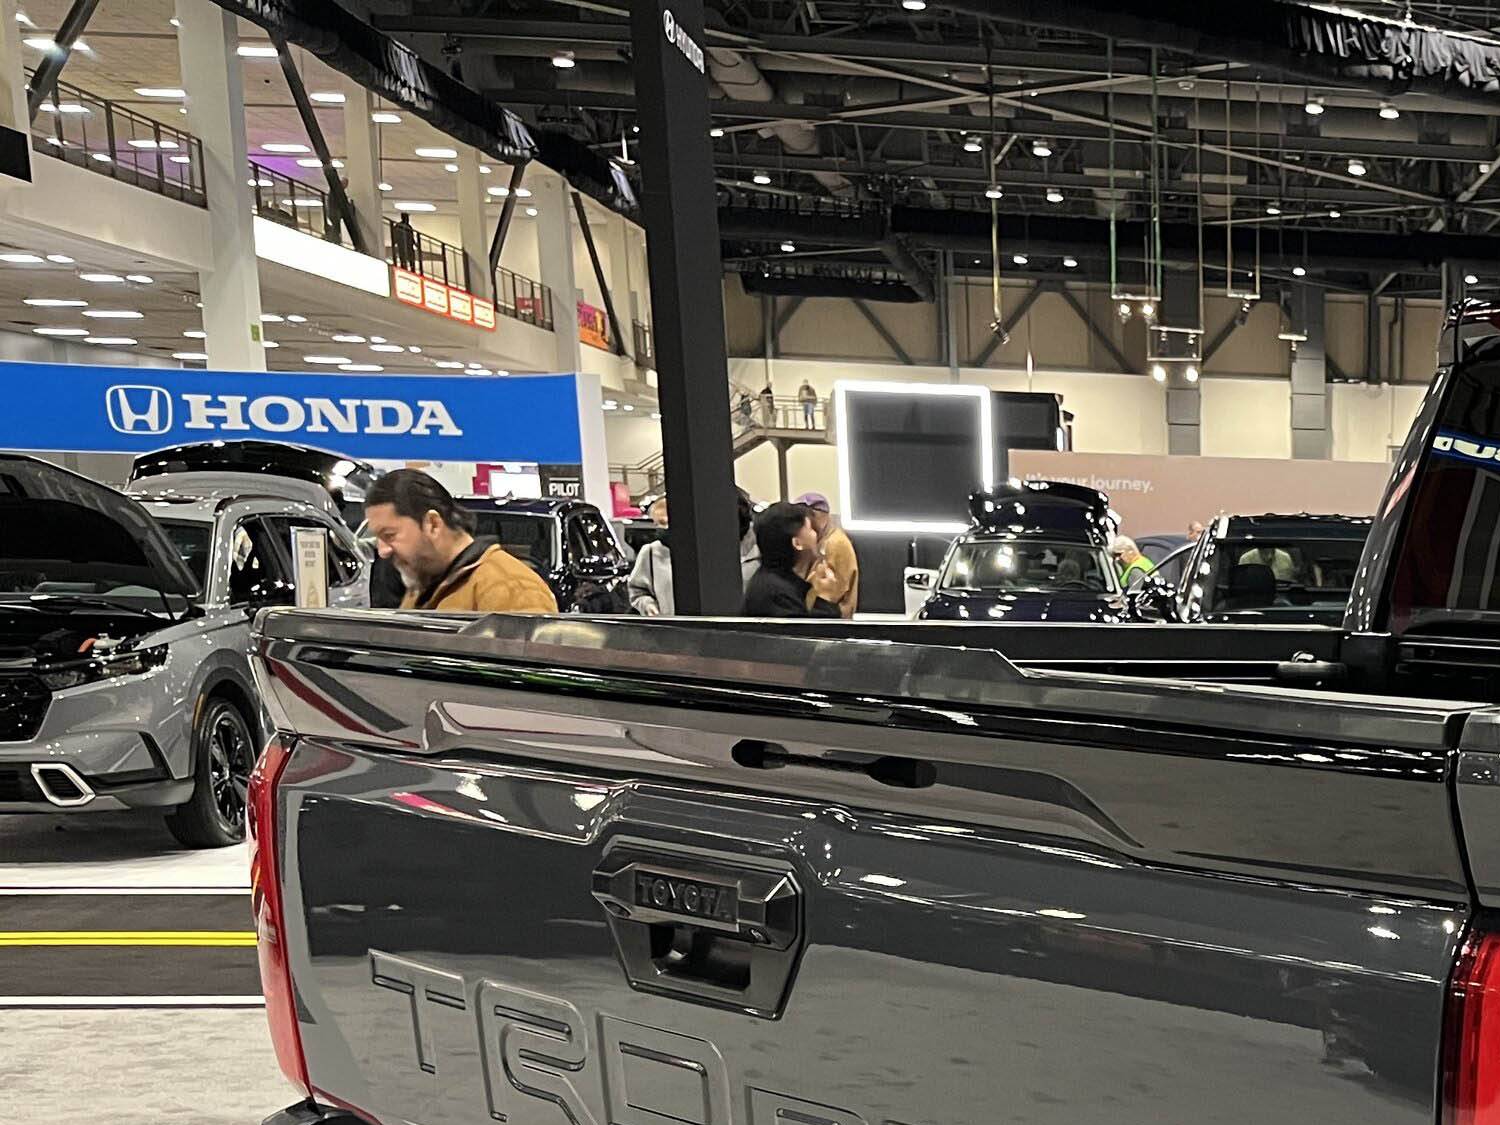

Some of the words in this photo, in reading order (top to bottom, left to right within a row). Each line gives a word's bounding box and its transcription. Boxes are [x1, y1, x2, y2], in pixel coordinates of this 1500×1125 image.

[181, 393, 463, 437] HONDA
[549, 482, 580, 497] PILOT
[638, 875, 734, 919] TOYOTA
